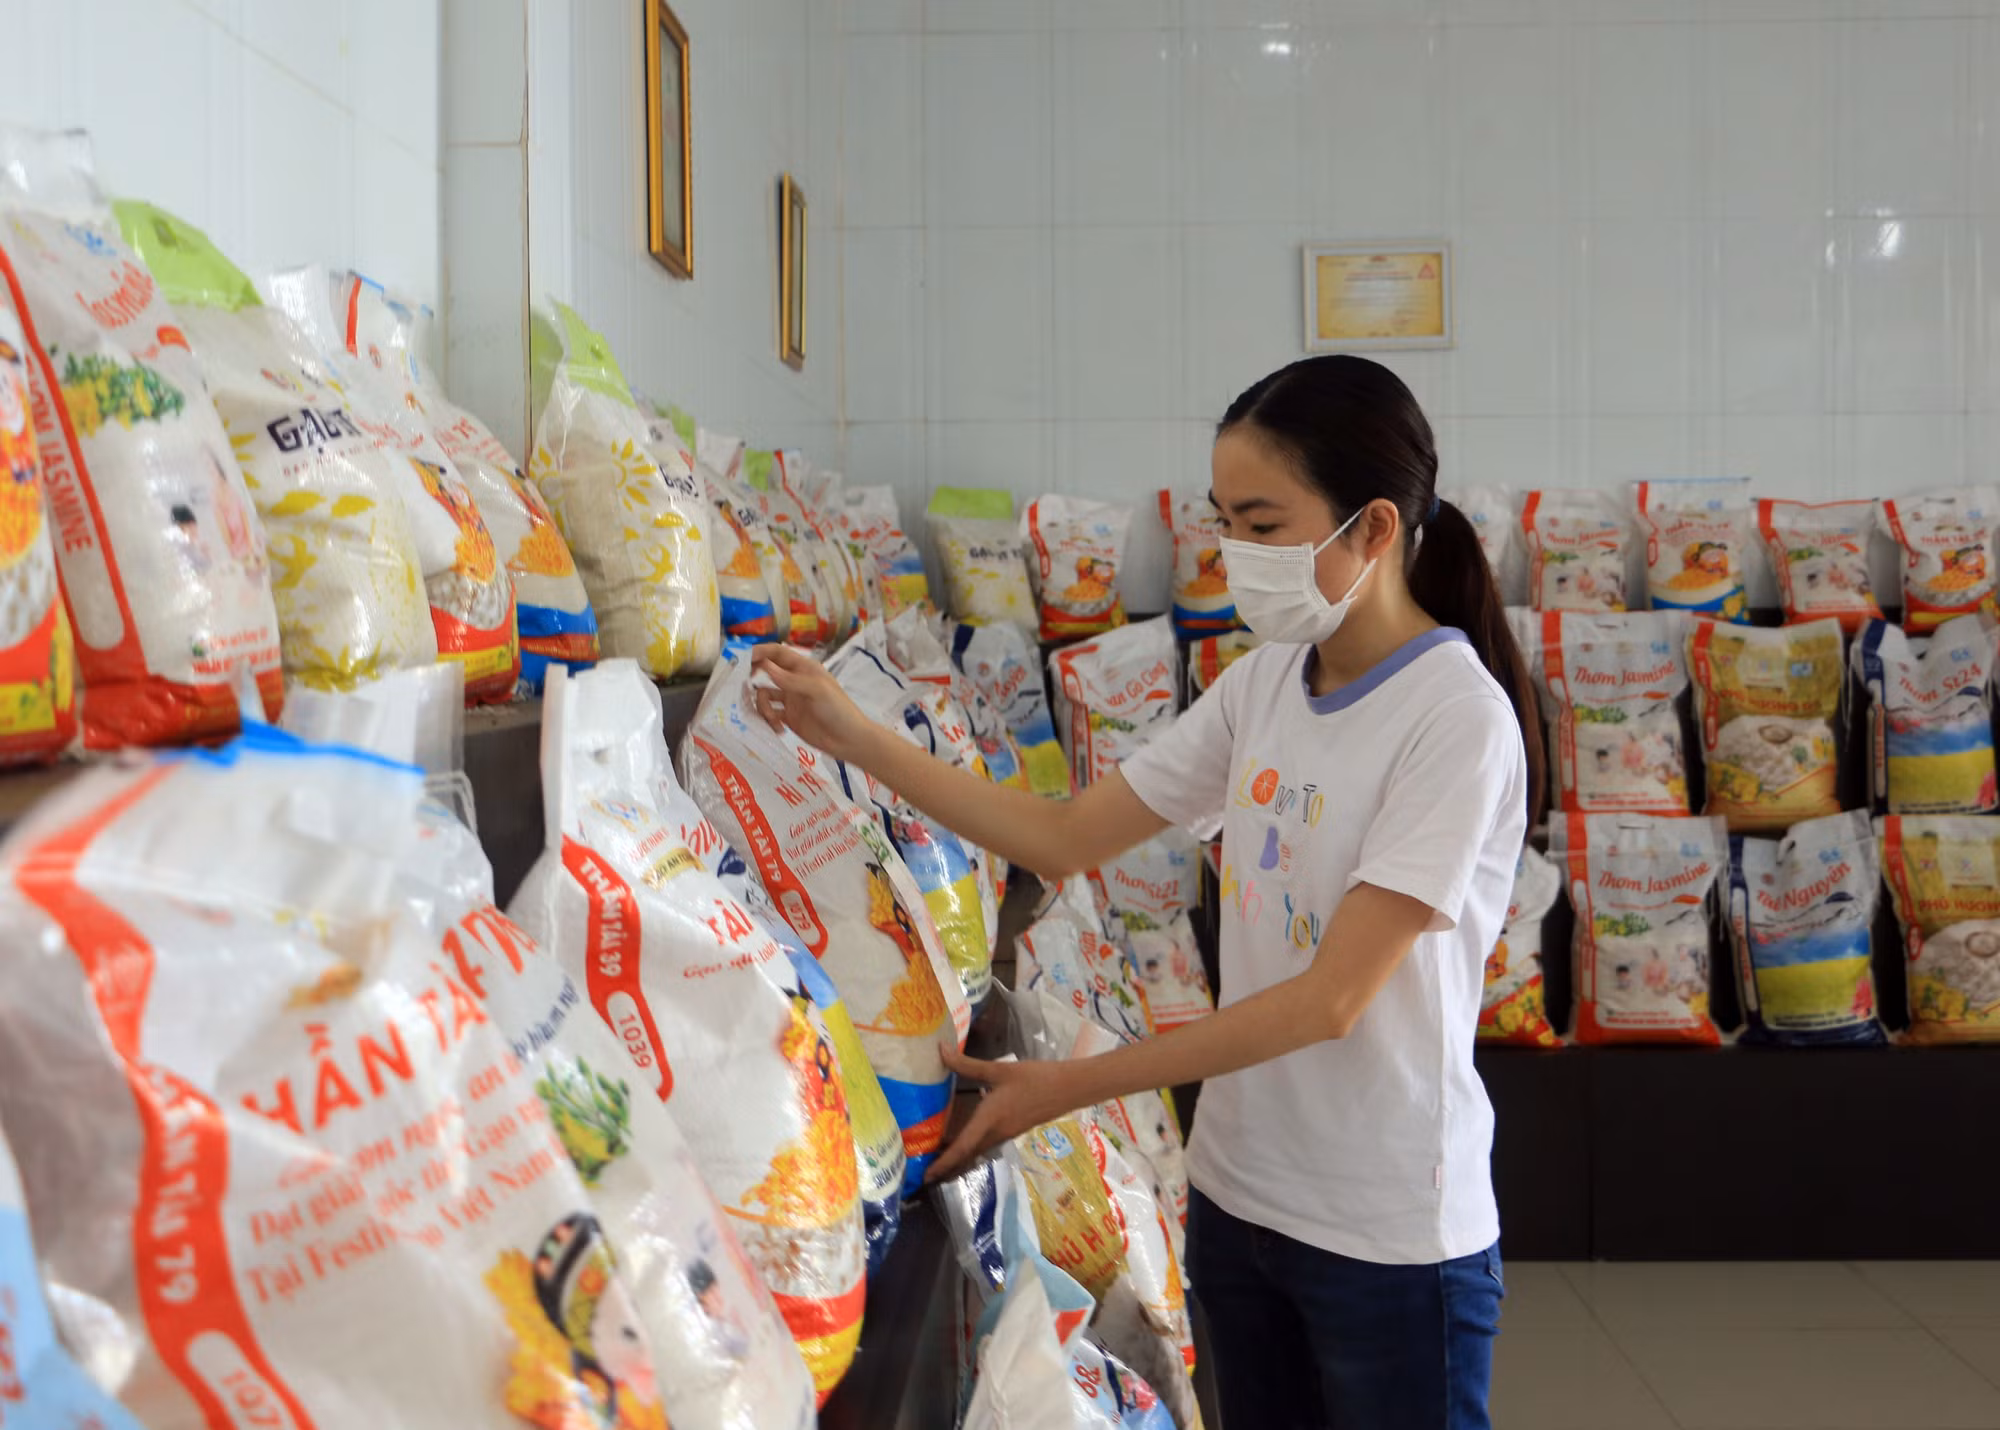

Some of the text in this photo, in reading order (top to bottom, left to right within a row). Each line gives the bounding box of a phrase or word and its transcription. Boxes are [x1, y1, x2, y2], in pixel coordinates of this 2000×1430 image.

[765, 855, 784, 883] 79
[1646, 860, 1712, 895] Jasmine
[599, 949, 623, 978] 39
[618, 1013, 653, 1069] 1039
[156, 1241, 199, 1304] 79
